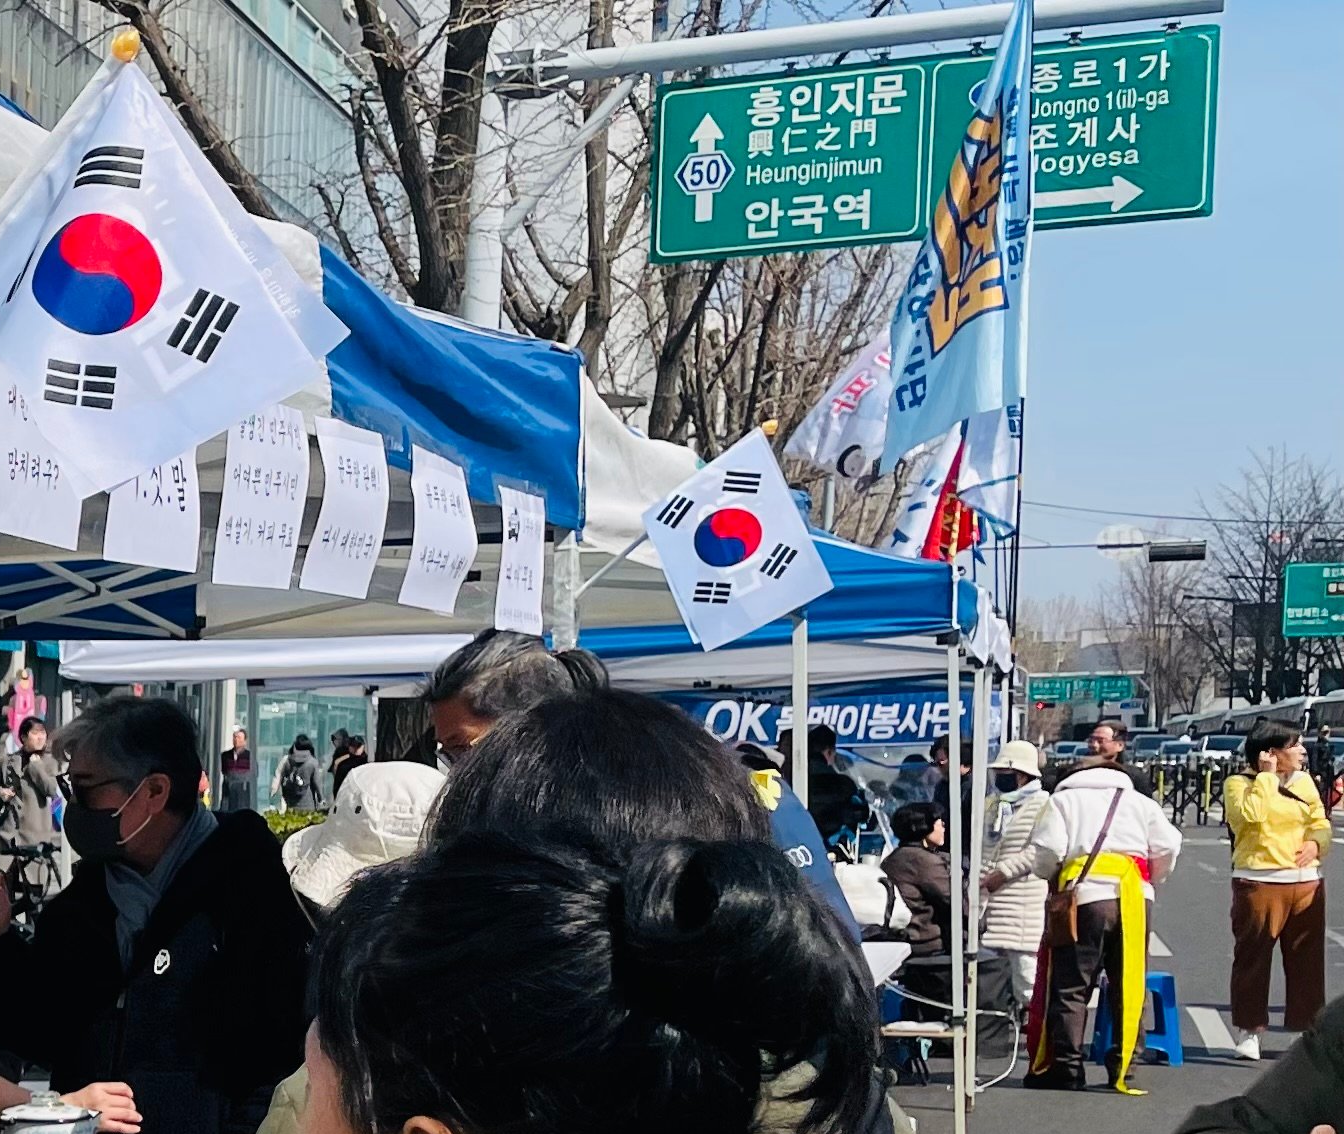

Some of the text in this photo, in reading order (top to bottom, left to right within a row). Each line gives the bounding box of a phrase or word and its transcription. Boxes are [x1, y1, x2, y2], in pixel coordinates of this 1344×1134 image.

[1031, 60, 1101, 94] 종로
[747, 73, 909, 127] 흥인지문
[1031, 87, 1170, 120] Jongno 1(il)-ga
[748, 119, 877, 158] 興仁之門
[1030, 114, 1142, 150] 조계사
[689, 160, 720, 186] 50
[746, 156, 882, 185] Heunginjimun
[745, 189, 872, 239] 안국역
[704, 700, 772, 742] OK
